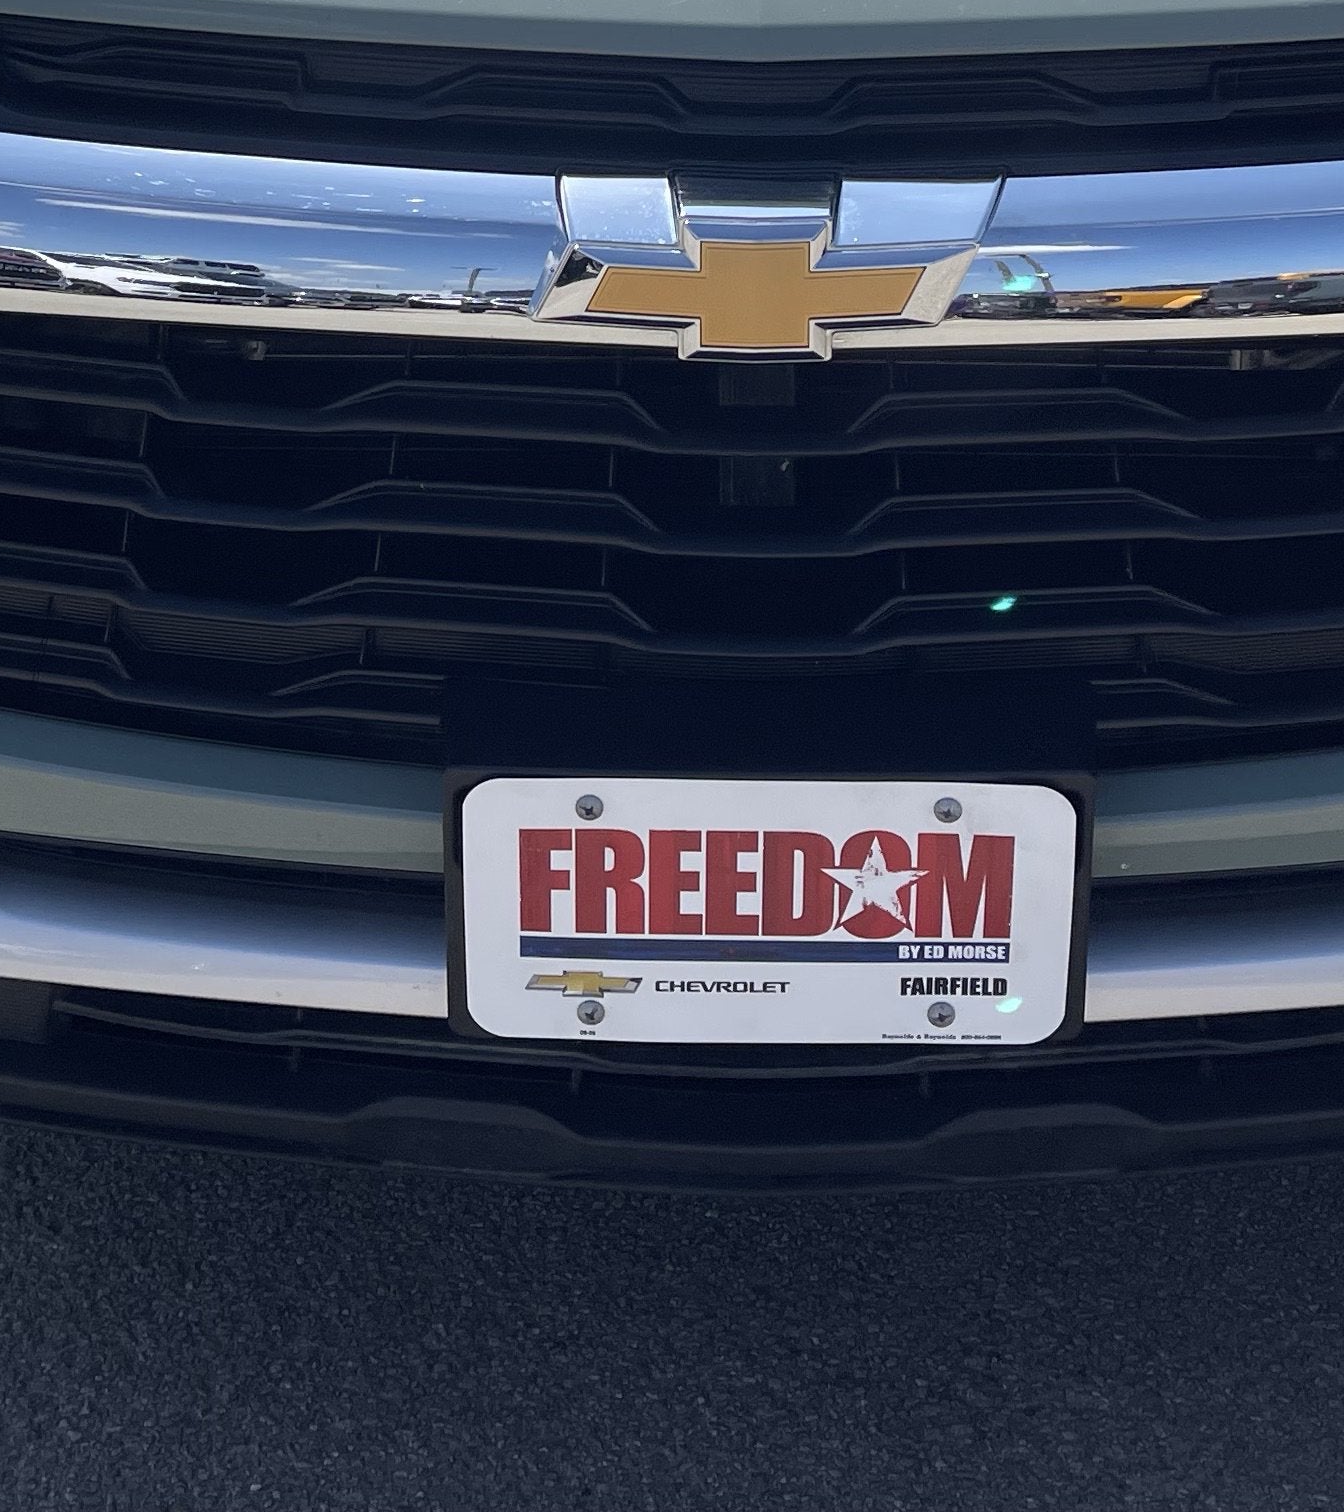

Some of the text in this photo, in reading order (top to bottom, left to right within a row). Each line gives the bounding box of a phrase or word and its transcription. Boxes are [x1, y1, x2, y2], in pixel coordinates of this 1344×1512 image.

[518, 828, 1015, 939] FREEDOM
[898, 944, 1006, 960] BY ED MORSE
[655, 980, 791, 993] CHEVROLET
[900, 977, 1008, 996] FAIRFIELD
